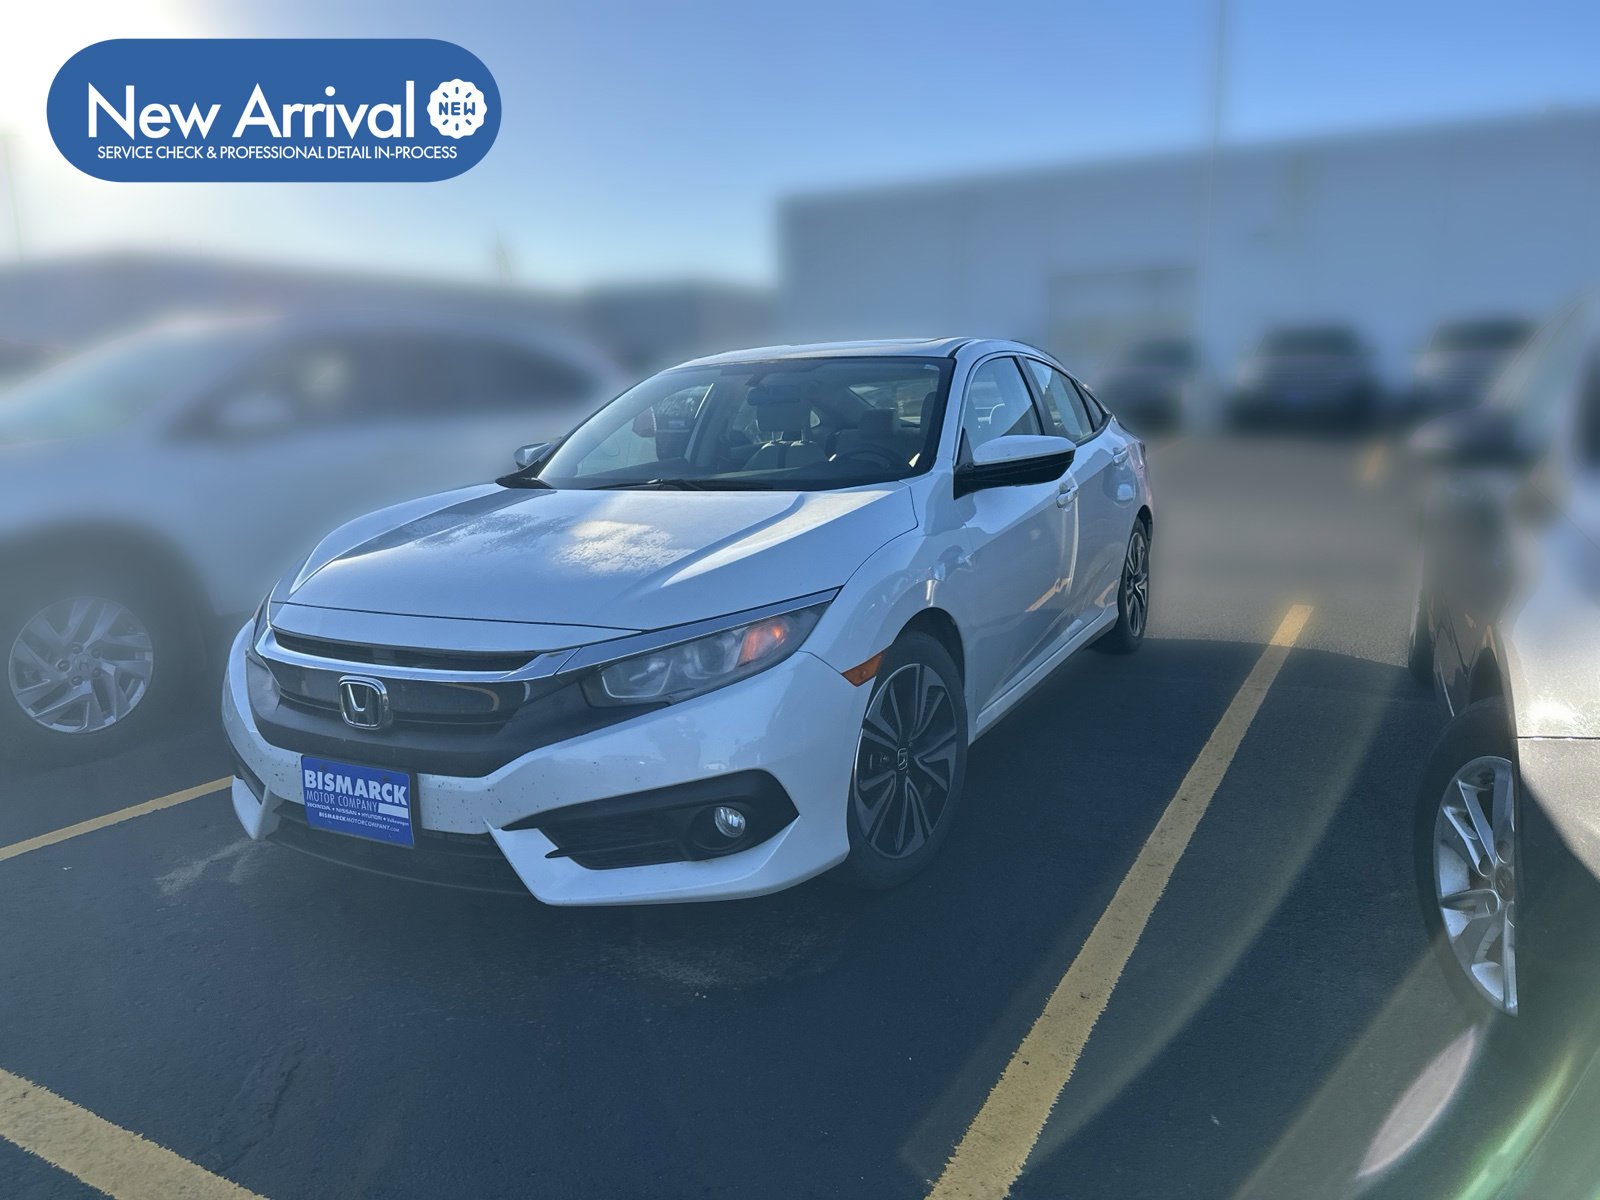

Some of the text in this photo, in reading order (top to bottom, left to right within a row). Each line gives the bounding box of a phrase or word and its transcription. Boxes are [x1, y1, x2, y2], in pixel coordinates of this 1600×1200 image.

[304, 769, 408, 806] BISMARCK
[306, 790, 378, 813] MOTOR COMPANY
[307, 802, 331, 811] HONDA
[335, 807, 357, 816] NISSAN
[361, 812, 383, 821] HYUNDAI
